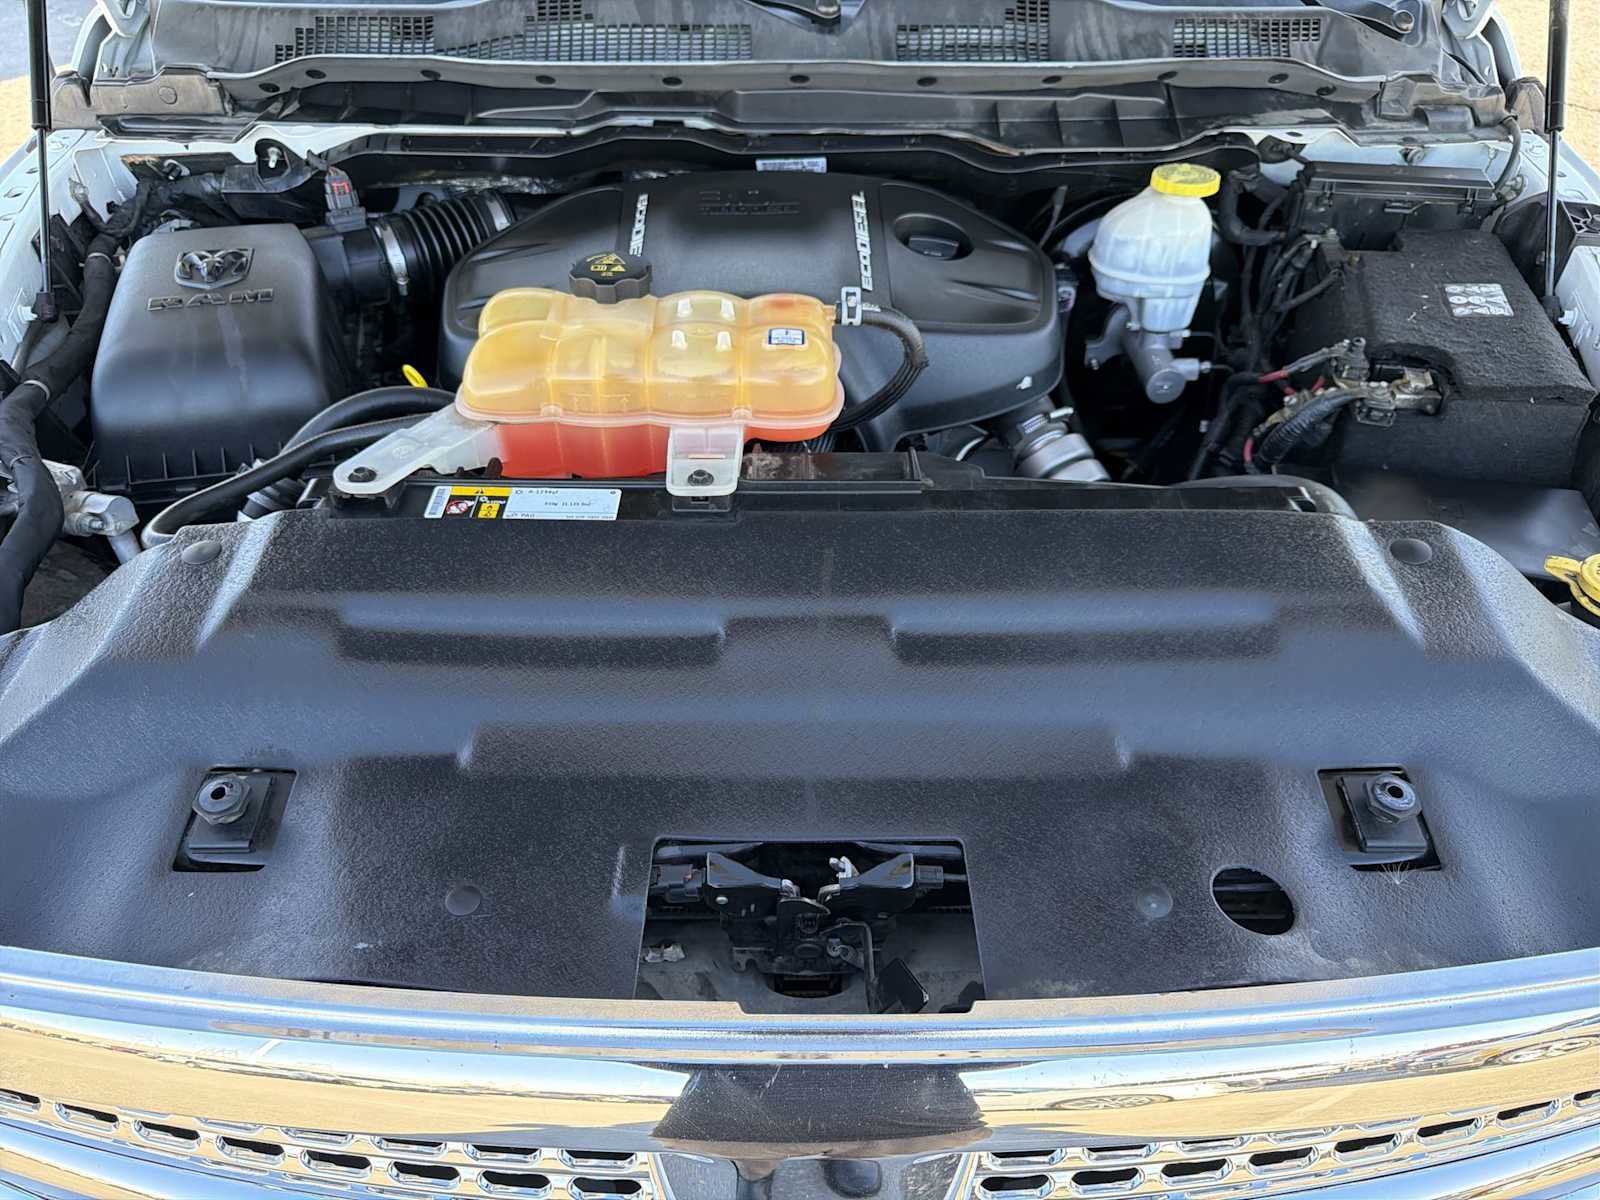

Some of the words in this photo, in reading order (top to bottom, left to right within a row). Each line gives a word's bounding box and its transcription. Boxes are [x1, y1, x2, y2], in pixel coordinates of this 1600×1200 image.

[629, 194, 648, 257] ECODIE
[851, 191, 873, 291] ECODIESEL
[147, 288, 274, 311] RAM
